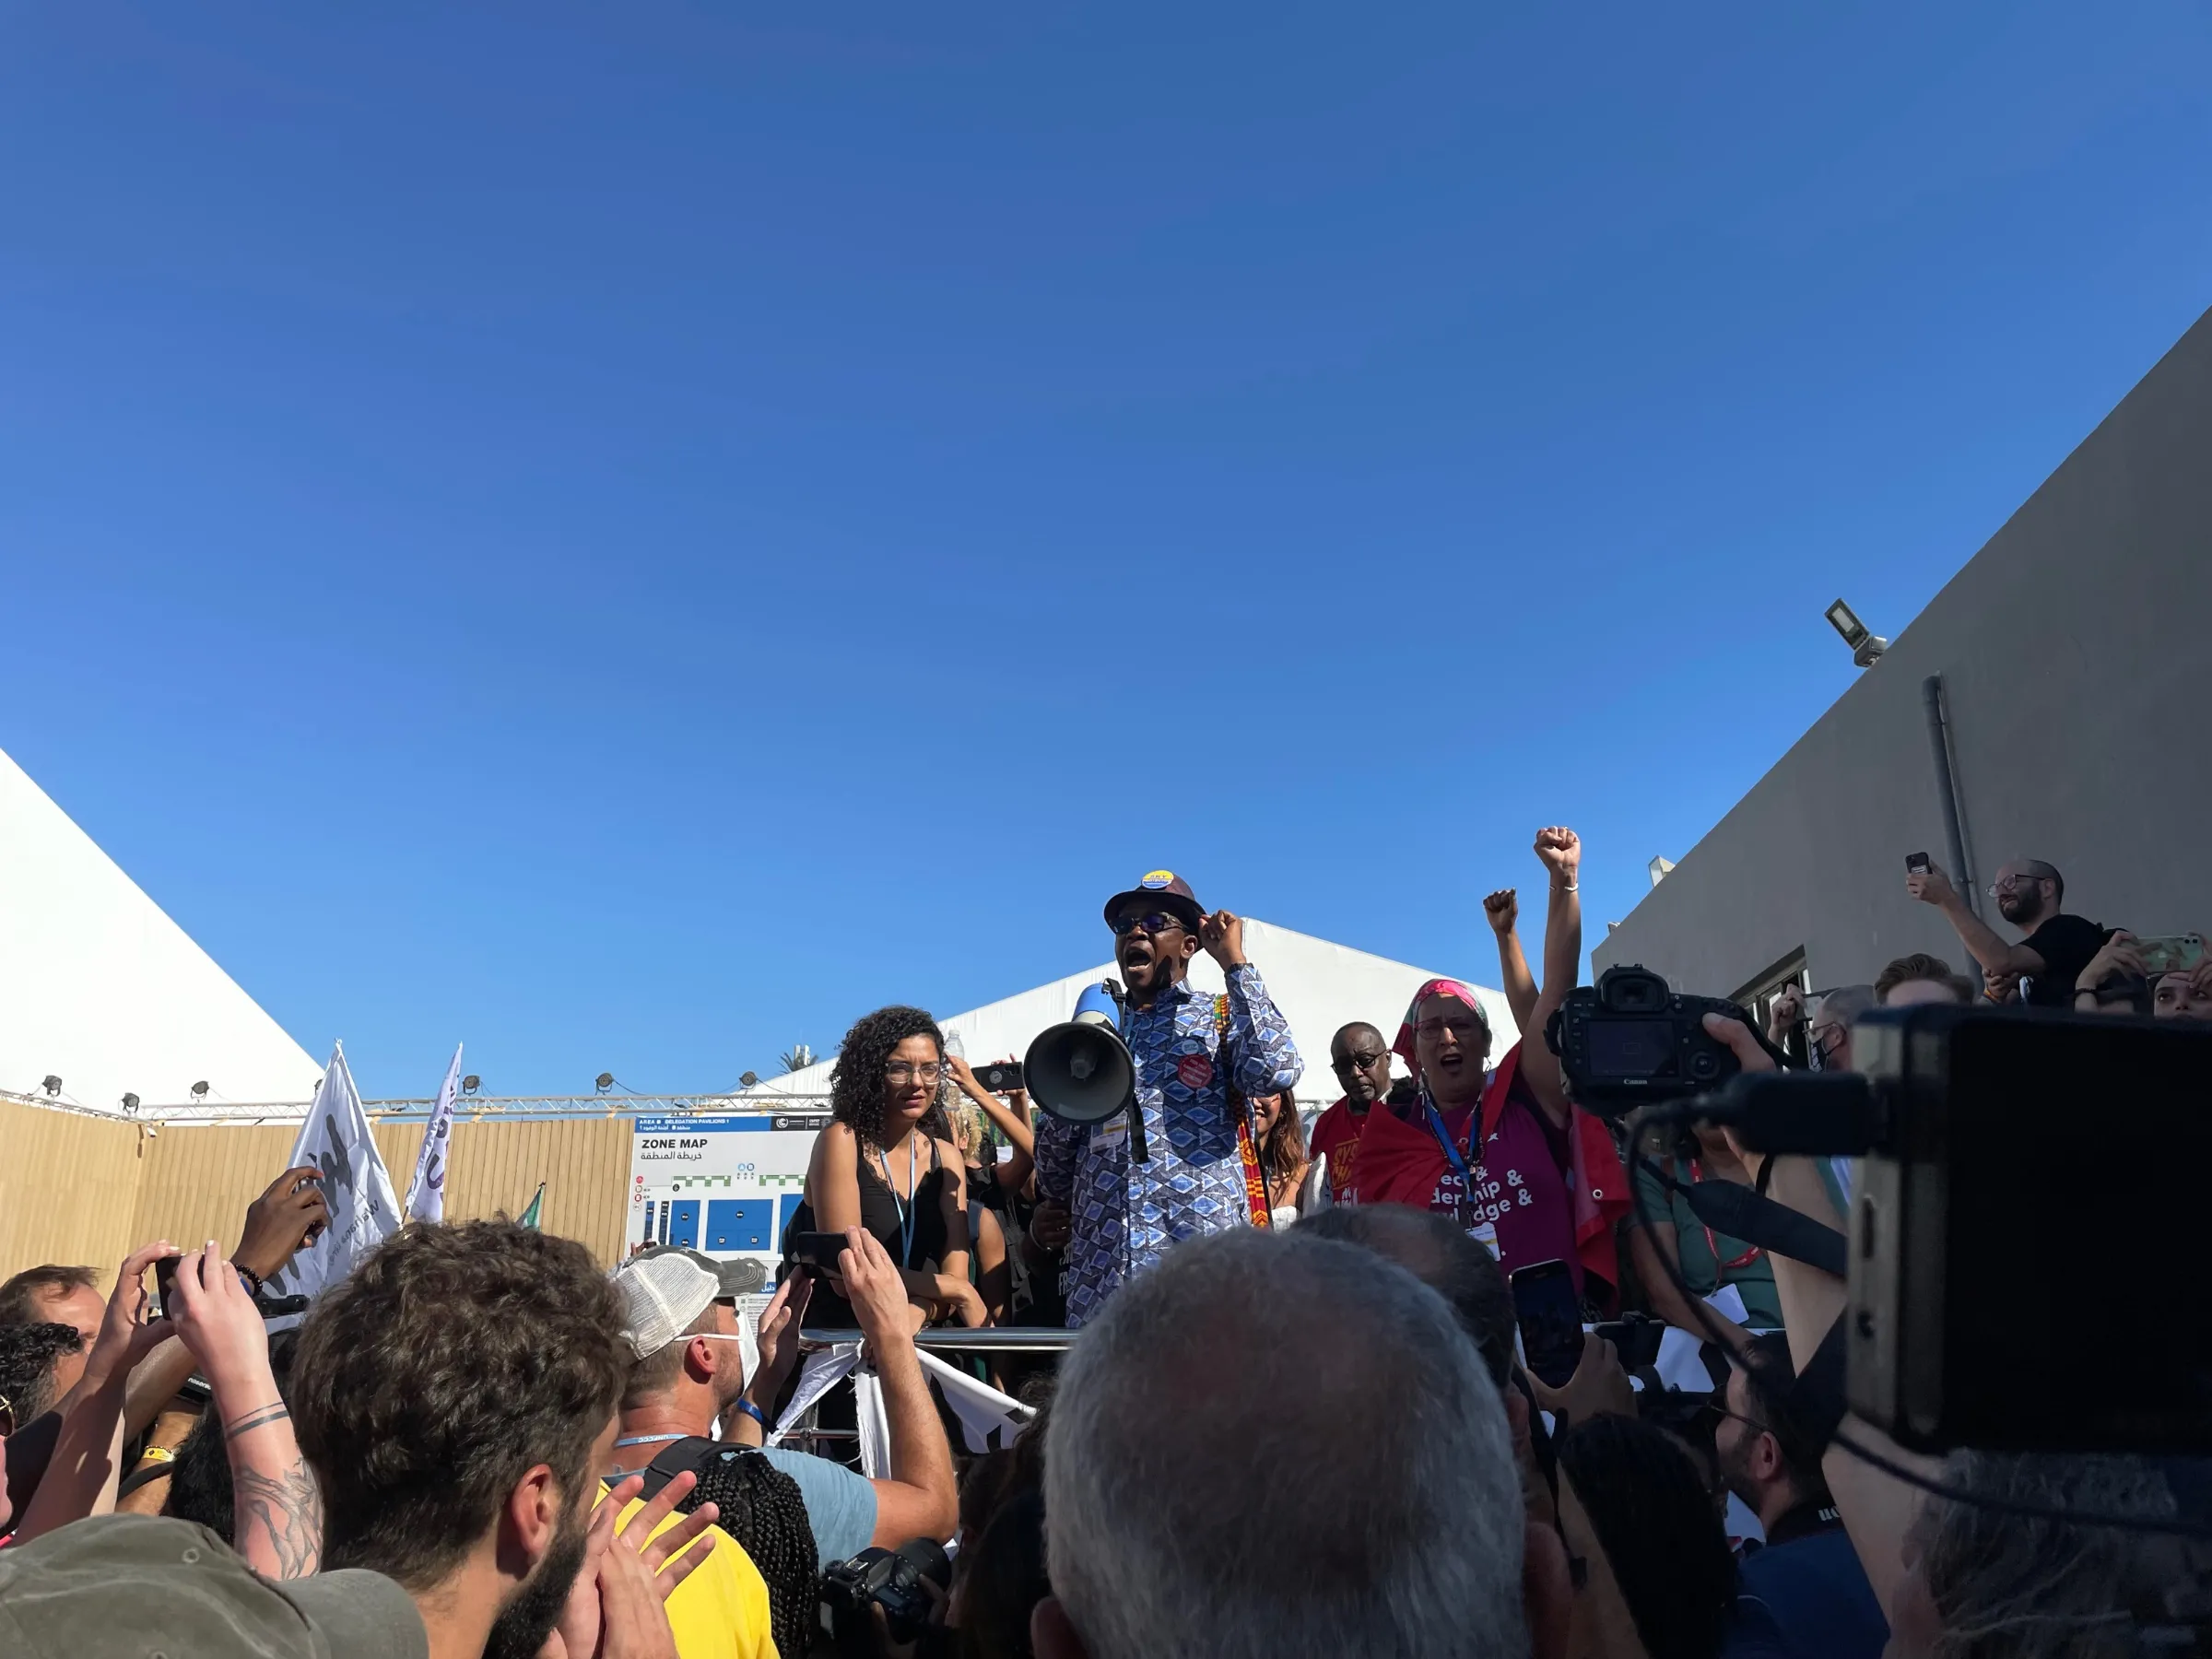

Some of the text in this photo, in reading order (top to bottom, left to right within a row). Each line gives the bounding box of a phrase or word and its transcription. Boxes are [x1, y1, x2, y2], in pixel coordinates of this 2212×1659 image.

[641, 1138, 708, 1148] ZONE MAP
[641, 1150, 702, 1161] خريطة المنطقة
[1333, 1143, 1358, 1166] SYS
[1332, 1164, 1351, 1188] CHA
[1440, 1174, 1464, 1187] ec
[1506, 1169, 1524, 1187] &
[1517, 1188, 1534, 1206] &
[760, 1284, 775, 1292] دليل
[638, 1434, 669, 1443] UNFCCC
